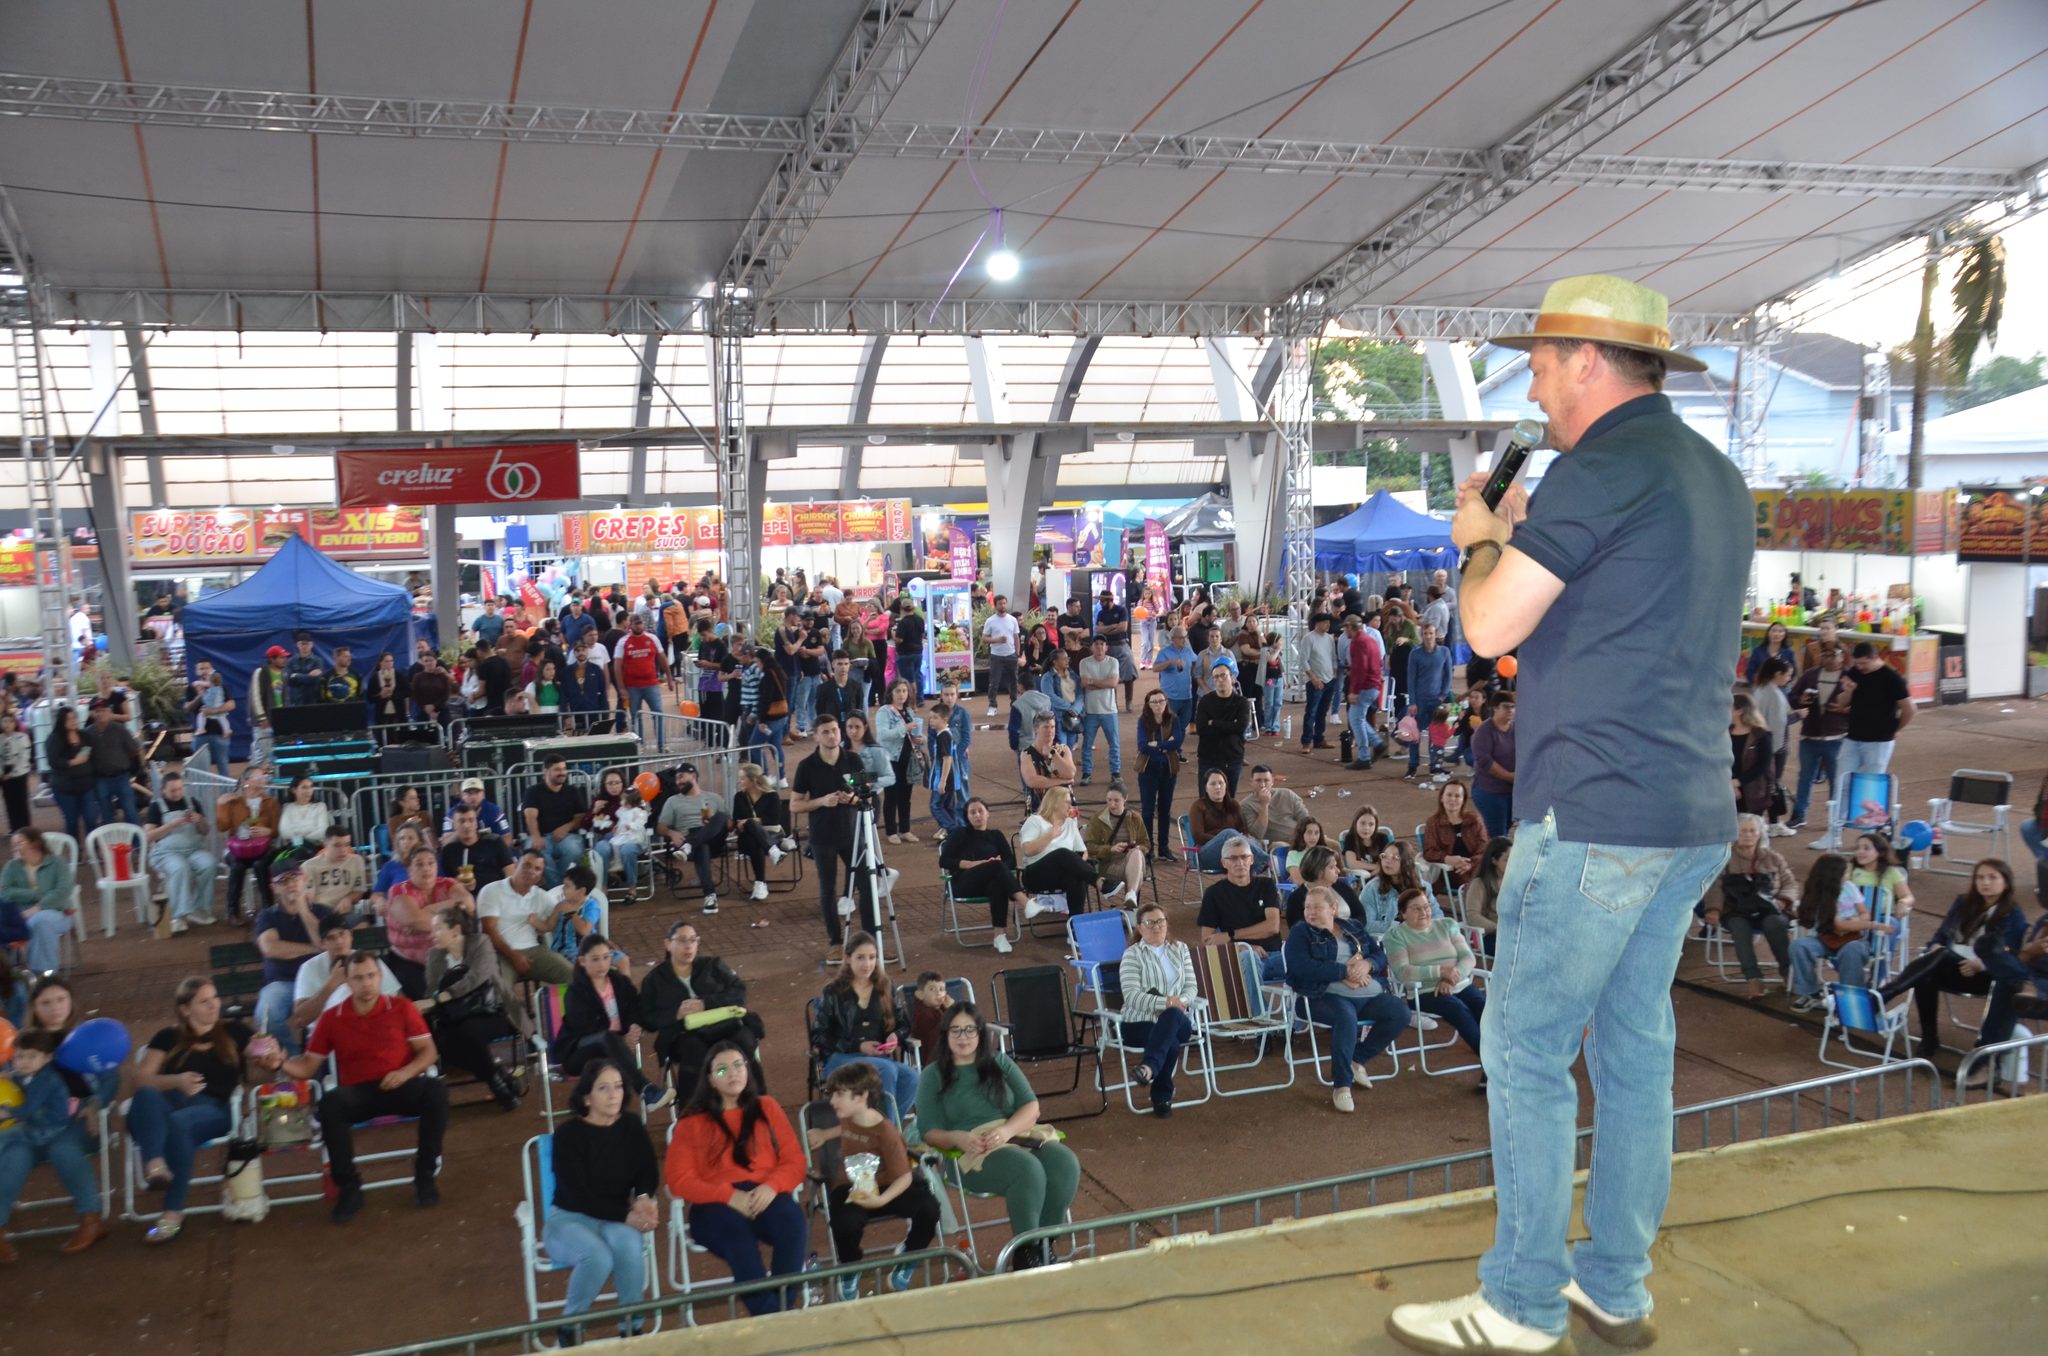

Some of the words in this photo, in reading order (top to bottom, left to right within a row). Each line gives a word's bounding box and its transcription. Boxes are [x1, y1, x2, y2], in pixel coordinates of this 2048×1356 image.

[377, 462, 455, 485] creluz
[486, 449, 542, 500] 60
[264, 512, 304, 524] XIS
[341, 512, 396, 532] XIS
[794, 512, 836, 522] CHURROS
[842, 510, 884, 520] CHURROS
[1776, 497, 1884, 531] DRINKS
[142, 514, 218, 537] SUPER
[592, 514, 686, 541] CREPES
[319, 532, 419, 546] ENTREVERO
